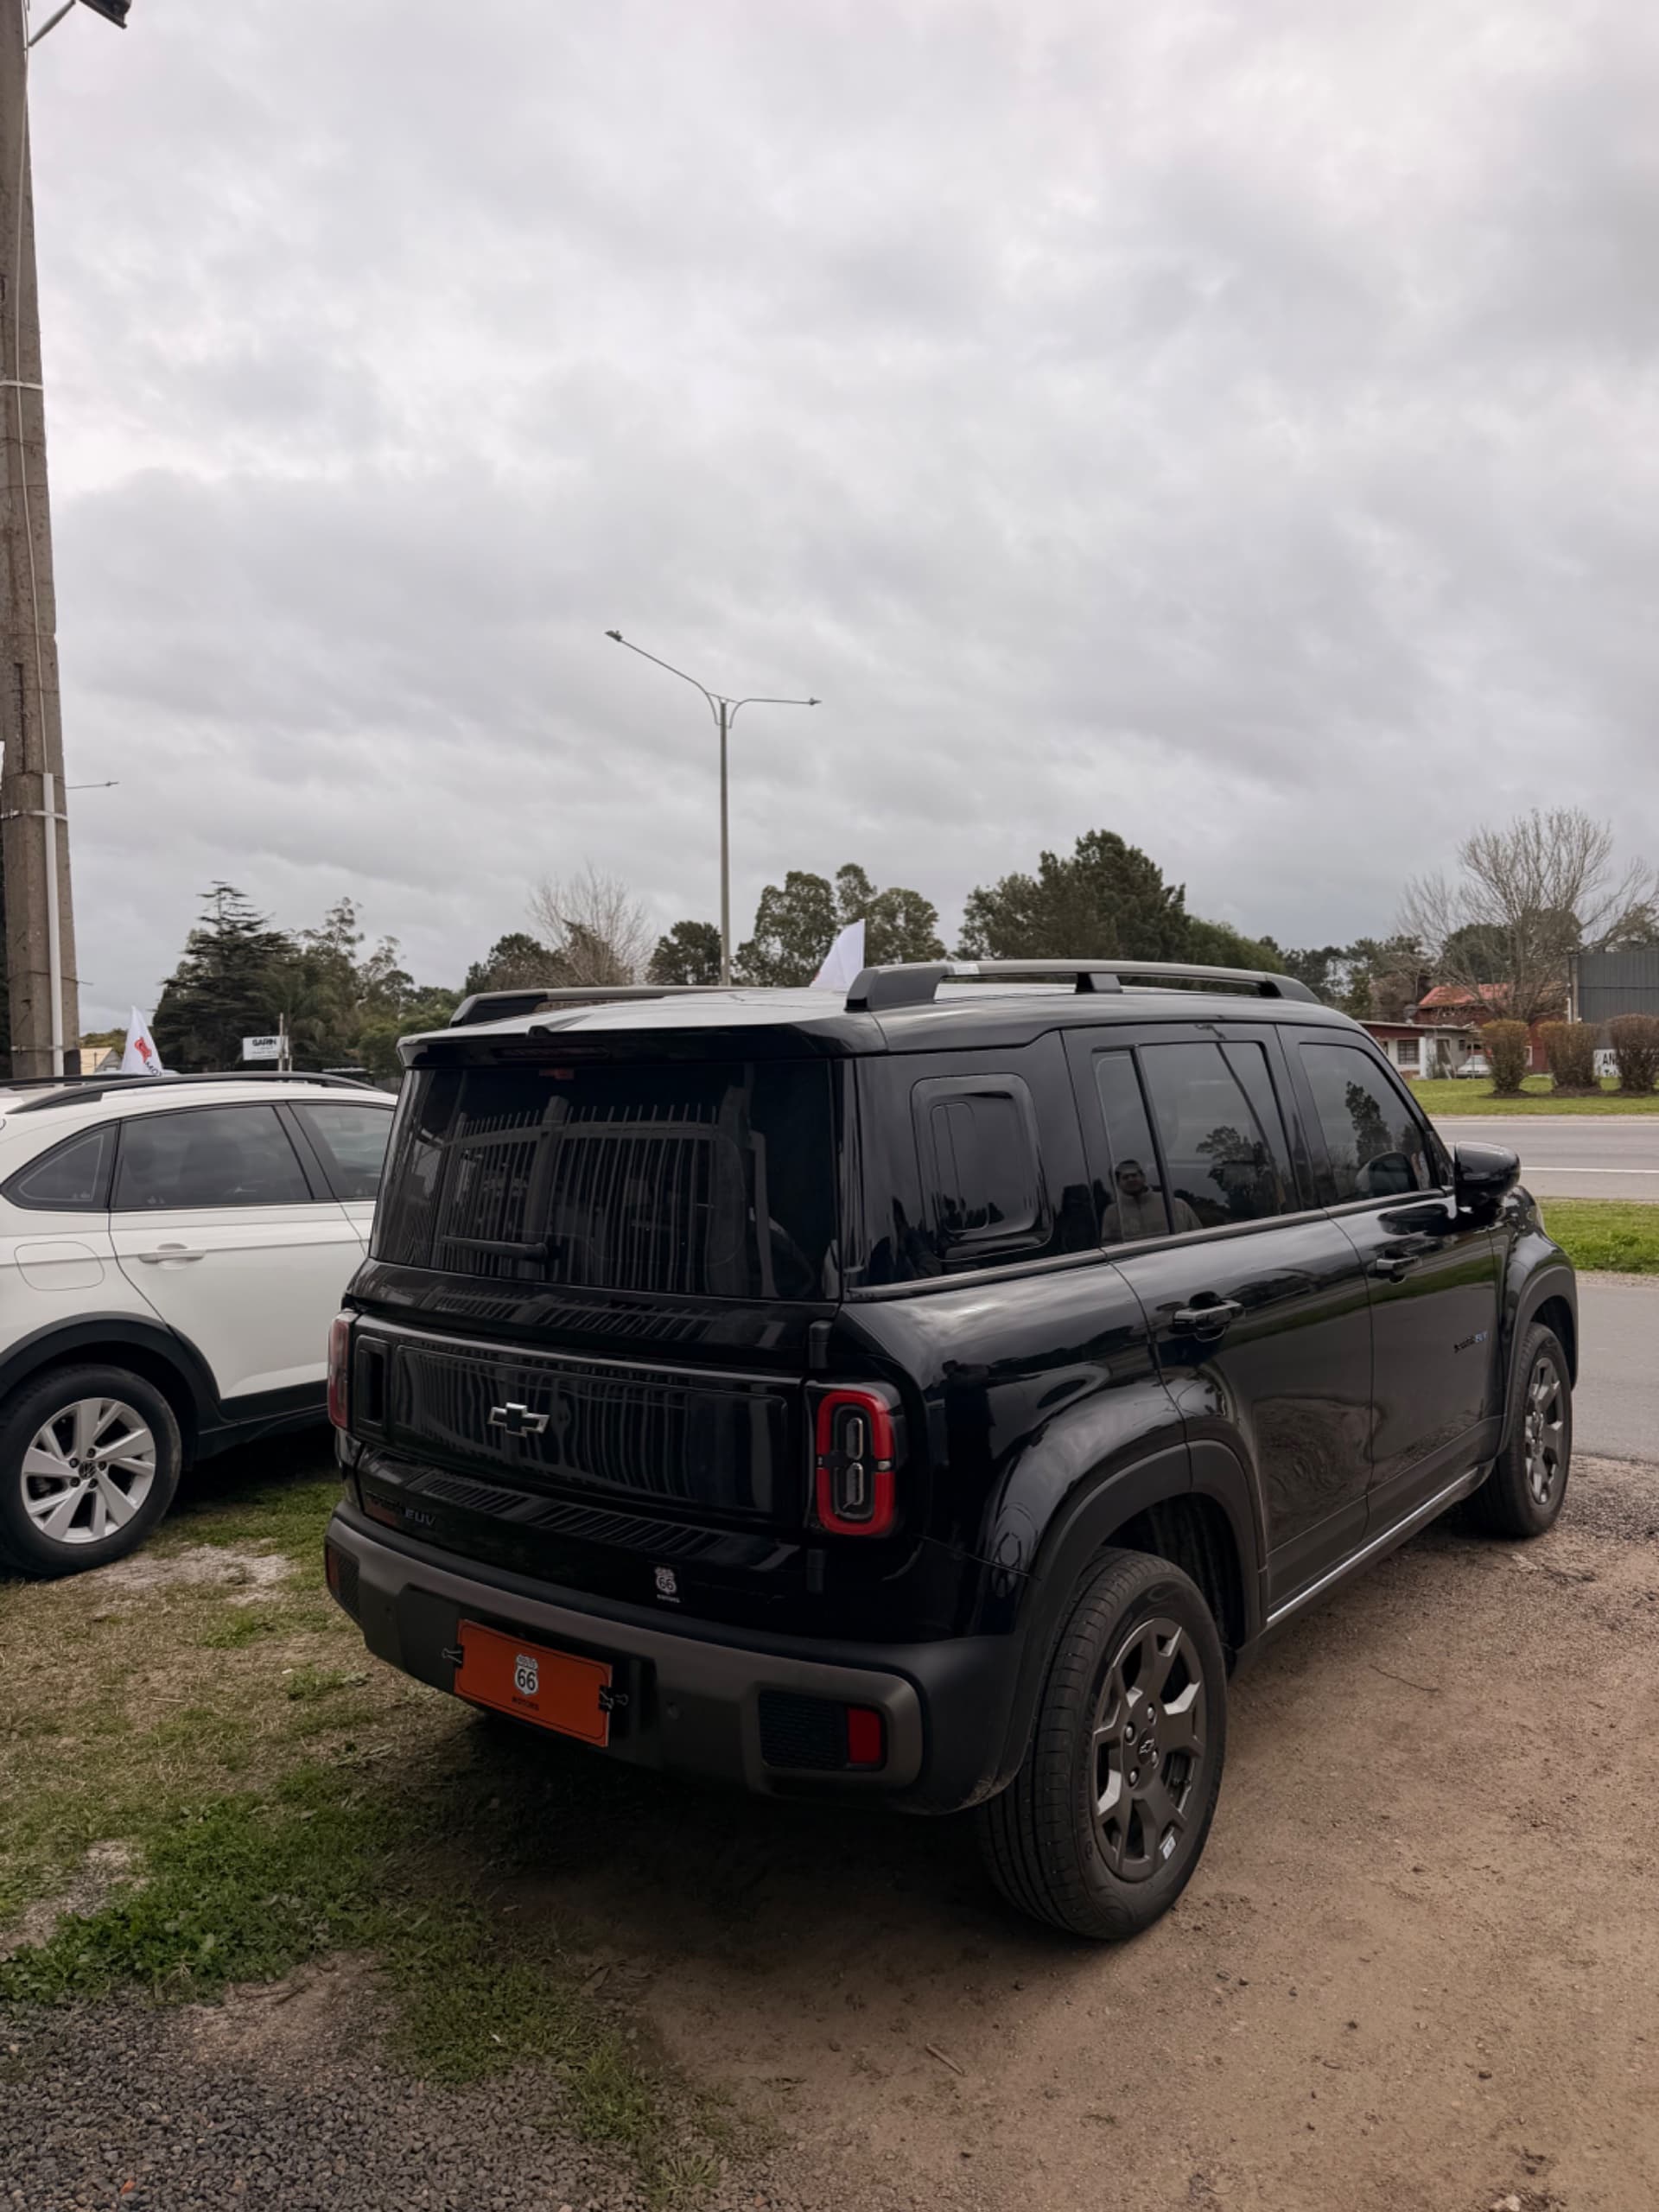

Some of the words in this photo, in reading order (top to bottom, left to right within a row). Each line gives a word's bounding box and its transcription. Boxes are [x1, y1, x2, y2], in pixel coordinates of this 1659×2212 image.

[405, 1507, 435, 1525] EUV
[658, 1577, 674, 1591] 66
[518, 1669, 536, 1690] 66
